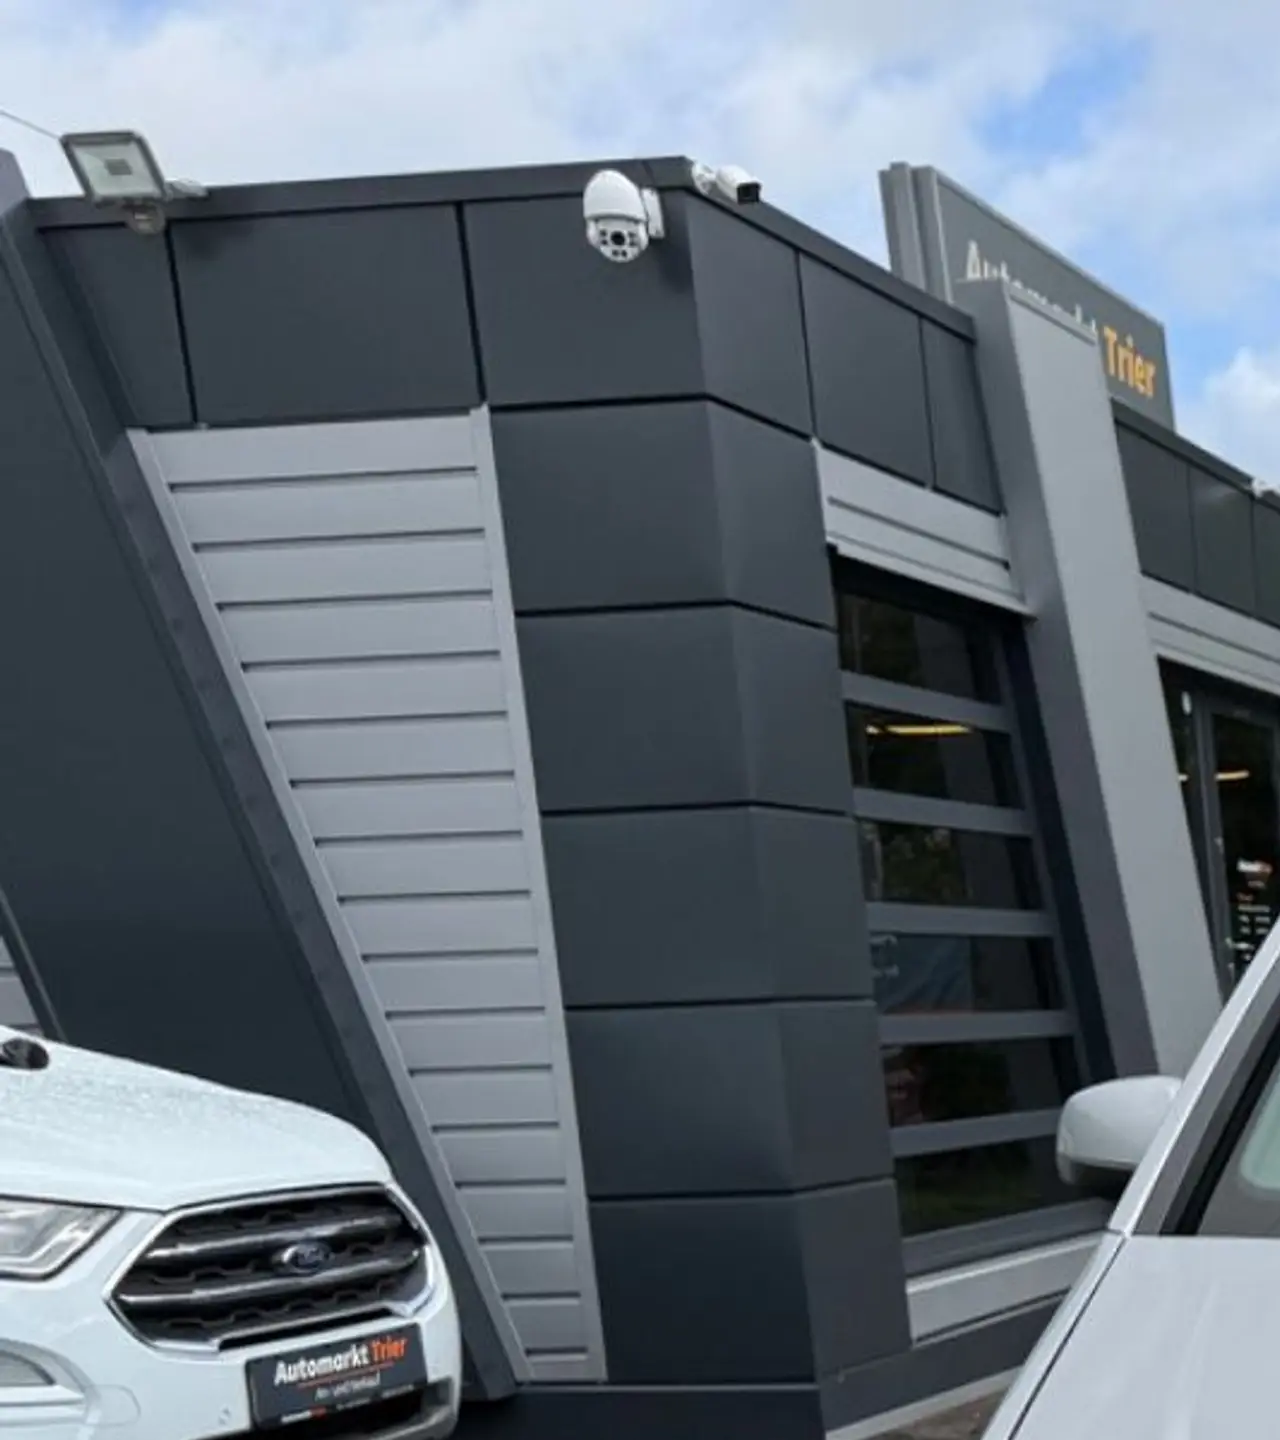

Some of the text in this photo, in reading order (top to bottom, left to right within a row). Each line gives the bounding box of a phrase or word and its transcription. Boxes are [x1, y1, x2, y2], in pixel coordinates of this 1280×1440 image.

[1104, 325, 1157, 398] Trier
[273, 1343, 369, 1386] Automarkt
[371, 1335, 409, 1363] Trier
